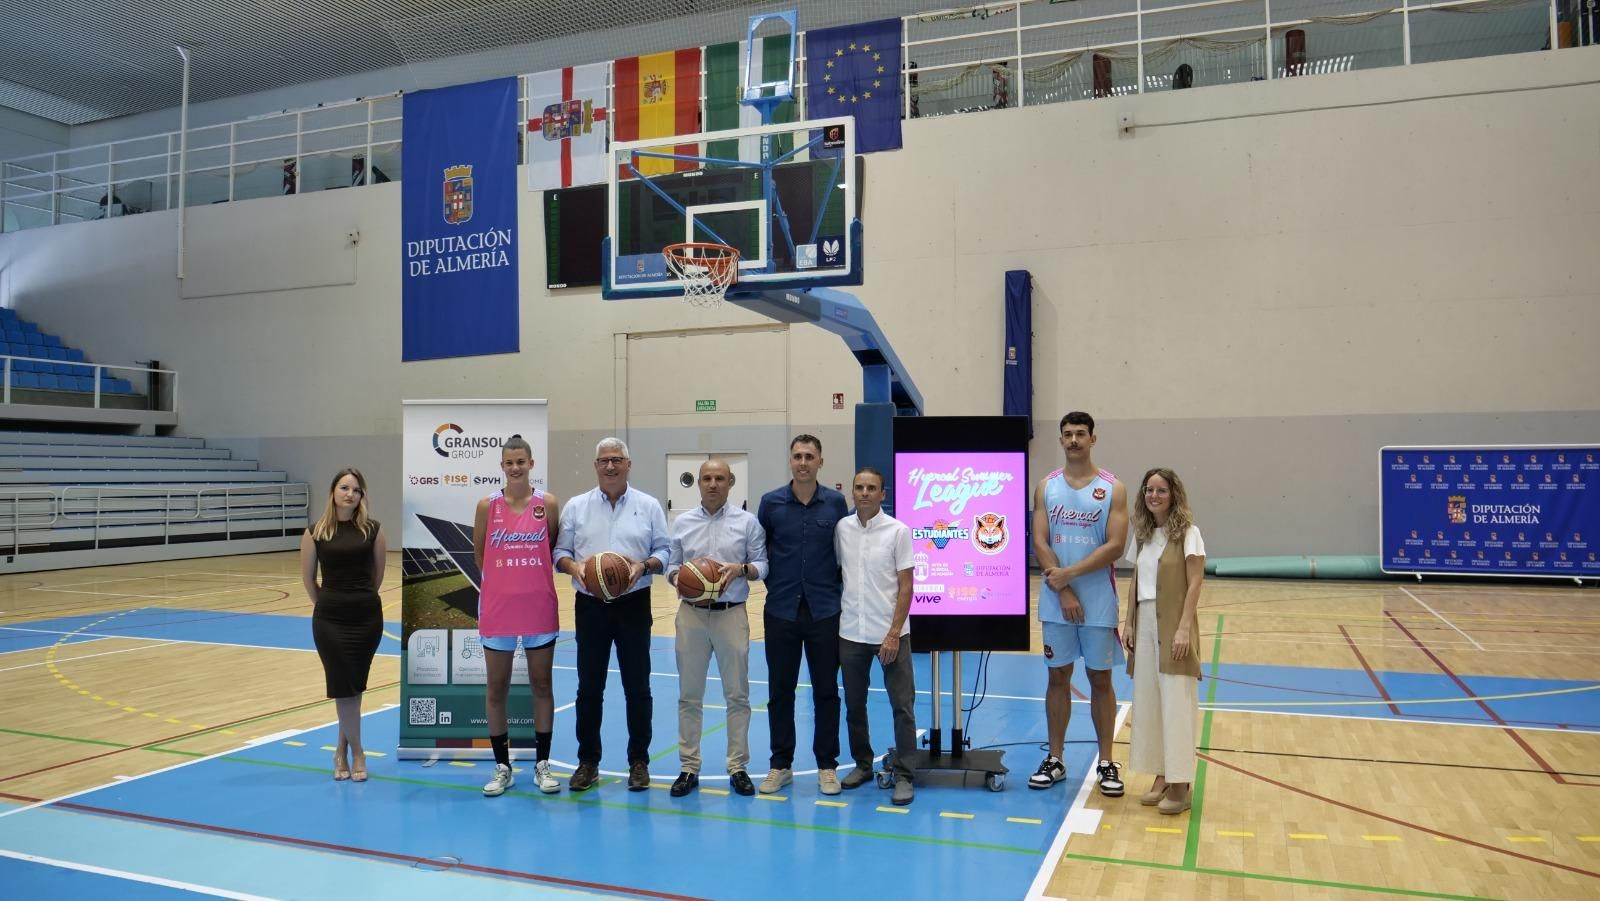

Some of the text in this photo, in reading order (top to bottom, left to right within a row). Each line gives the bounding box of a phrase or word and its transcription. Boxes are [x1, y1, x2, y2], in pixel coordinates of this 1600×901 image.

[408, 227, 512, 257] DIPUTACIÓN
[409, 247, 510, 277] DE ALMERÍA
[445, 437, 512, 448] GRANSOL
[451, 450, 484, 459] GROUP
[961, 466, 1014, 483] Summer
[420, 477, 439, 485] GRS
[482, 476, 501, 485] PVH
[913, 480, 1004, 516] League
[1471, 503, 1540, 513] DIPUTACIÓN
[1049, 504, 1102, 525] Huercal
[1473, 513, 1540, 524] DE ALMERÍA
[490, 526, 546, 549] Huercal
[912, 528, 969, 540] ESTUDIANTES
[1055, 533, 1097, 544] BRISOL
[495, 557, 543, 568] BRISOL
[914, 594, 941, 603] vive
[440, 713, 450, 723] in
[470, 717, 535, 725] wwwolar.com
